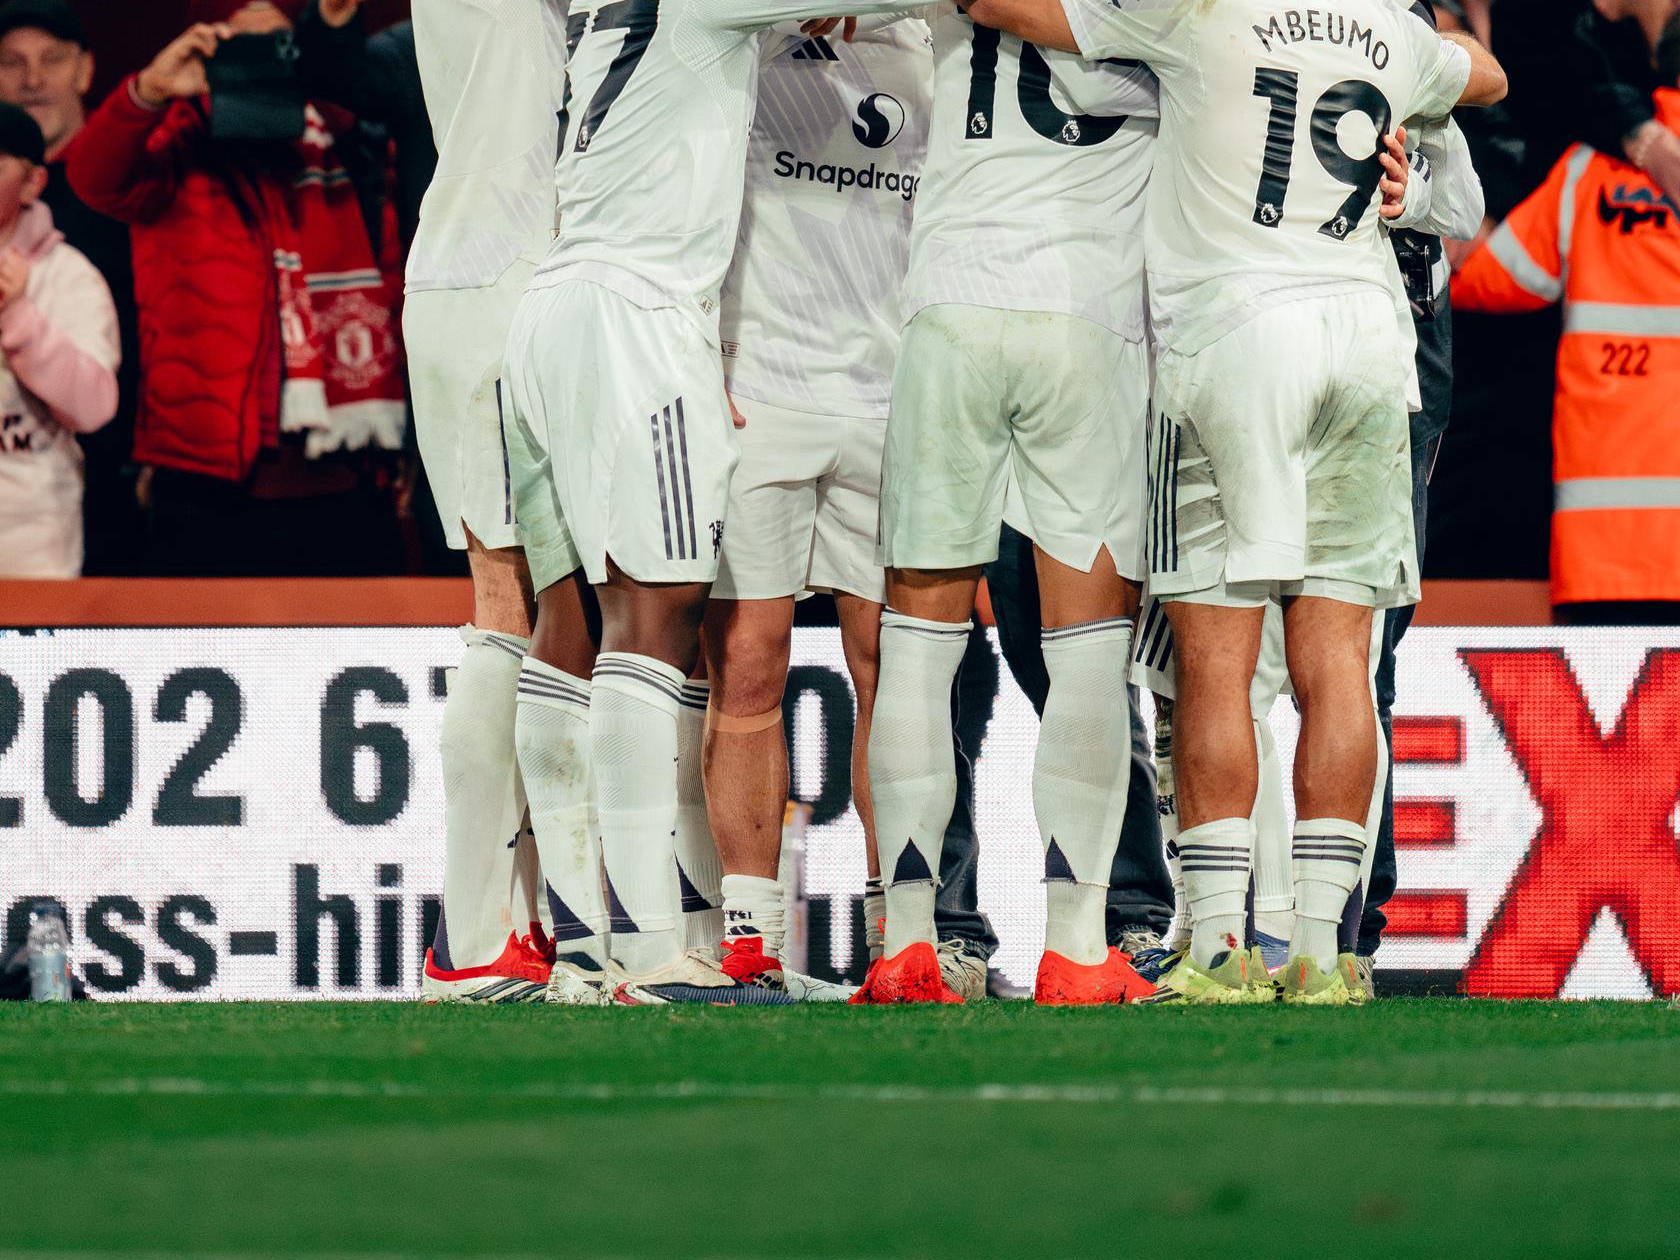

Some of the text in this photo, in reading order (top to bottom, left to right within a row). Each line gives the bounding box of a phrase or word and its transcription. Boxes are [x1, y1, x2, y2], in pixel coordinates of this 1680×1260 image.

[1252, 9, 1389, 71] MBEUMO
[1252, 67, 1392, 241] 19
[1600, 343, 1649, 376] 222
